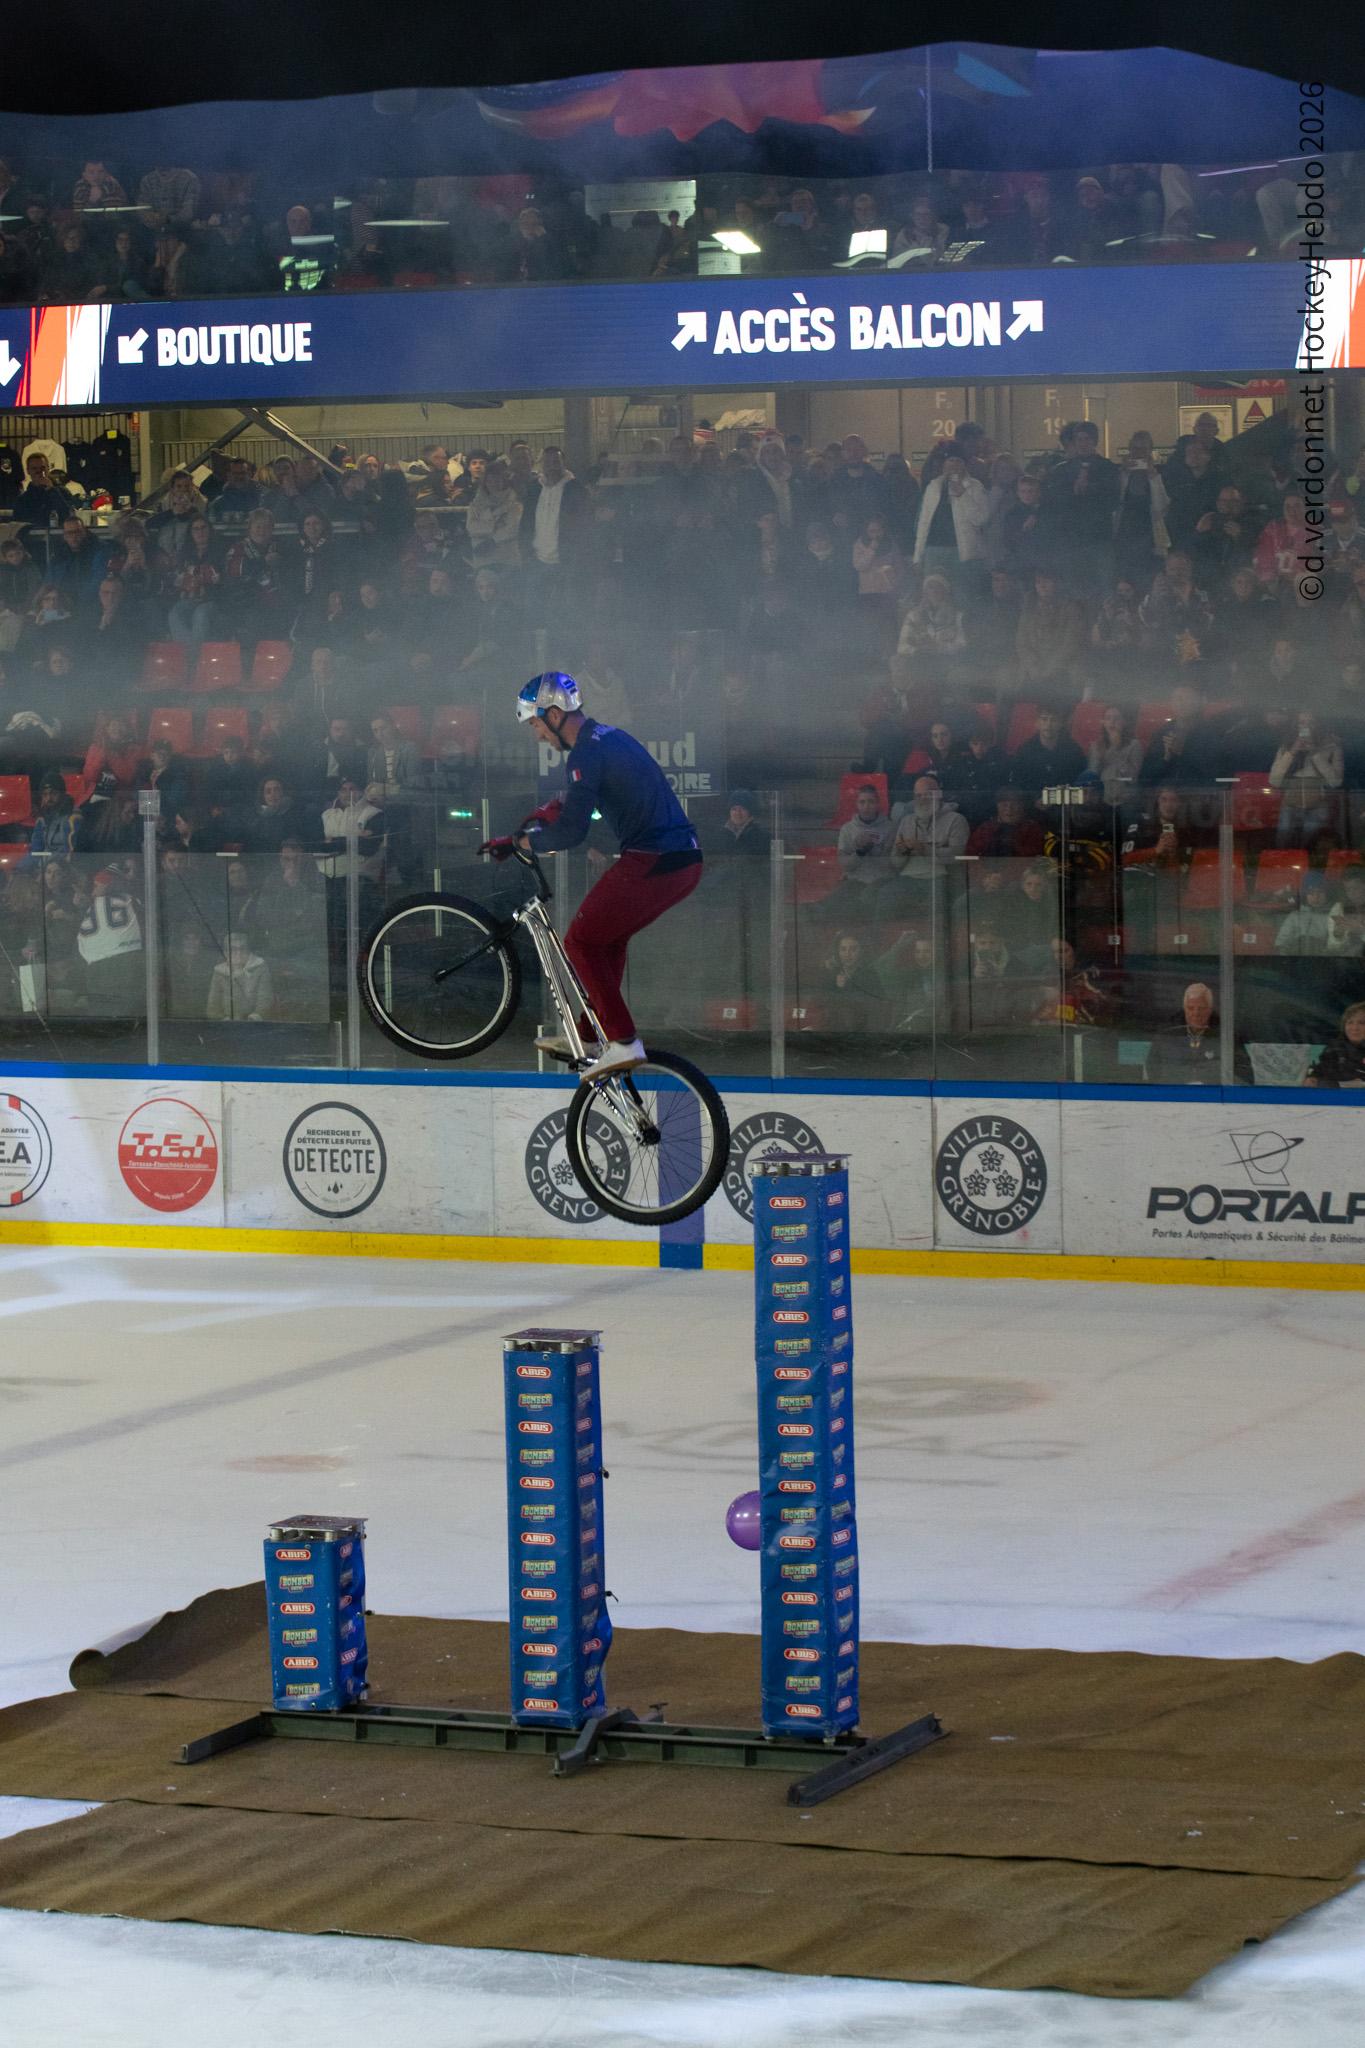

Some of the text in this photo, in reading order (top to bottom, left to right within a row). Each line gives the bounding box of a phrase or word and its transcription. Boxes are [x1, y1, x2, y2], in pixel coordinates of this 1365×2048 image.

[713, 292, 1001, 354] ACCÈS BALCON
[157, 323, 312, 367] BOUTIQUE
[931, 419, 956, 437] 20
[306, 1129, 351, 1137] RECHERCHE
[532, 1114, 624, 1155] VIL DE
[729, 1117, 785, 1154] VILLE
[132, 1132, 205, 1158] T.E.I
[345, 1138, 372, 1146] FUITES
[943, 1120, 1039, 1165] VILLE DE
[294, 1148, 375, 1174] DETECTE
[531, 1165, 626, 1218] GRENOLE
[773, 1198, 803, 1208] ABUS
[941, 1176, 1042, 1231] GRENOBLE
[1152, 1228, 1182, 1239] Portes
[1186, 1229, 1253, 1243] Automatiques
[1256, 1231, 1264, 1241] &
[1267, 1230, 1306, 1242] Sécurité
[1309, 1232, 1327, 1242] des
[775, 1256, 803, 1264] ABUS
[777, 1313, 805, 1321] ABUS
[520, 1368, 547, 1376] ABUS
[778, 1369, 807, 1378] ABUS
[522, 1423, 550, 1432] ABUS
[782, 1426, 810, 1434] ABUS
[524, 1479, 551, 1487] ABUS
[783, 1482, 812, 1491] ABUS
[525, 1535, 551, 1543] ABUS
[784, 1538, 812, 1547] ABUS
[280, 1551, 308, 1559] ABUS
[525, 1590, 552, 1598] ABUS
[786, 1594, 814, 1602] ABUS
[526, 1645, 553, 1654] ABUS
[788, 1650, 815, 1659] ABUS
[287, 1659, 315, 1667] ABUS
[527, 1700, 554, 1709] ABUS
[790, 1706, 817, 1715] ABUS
